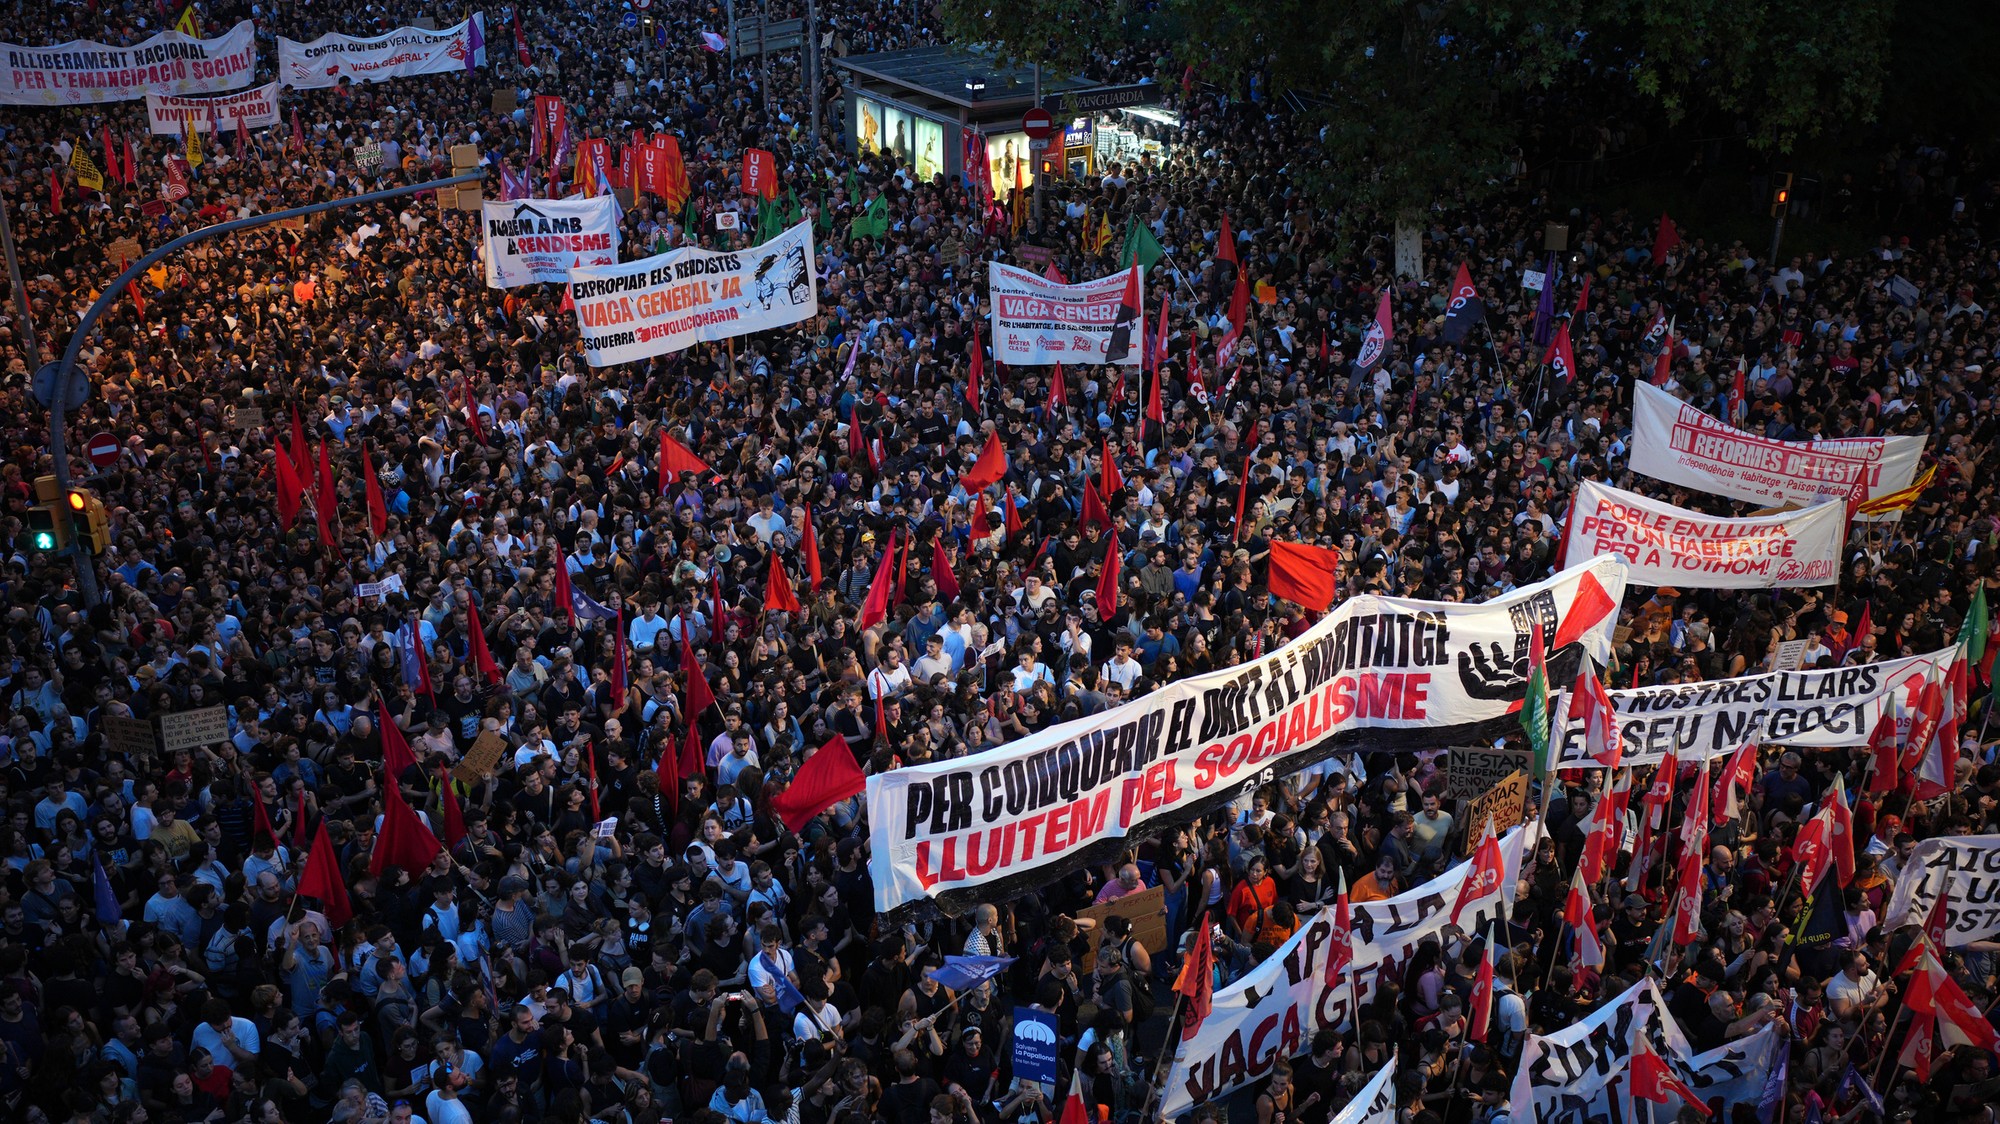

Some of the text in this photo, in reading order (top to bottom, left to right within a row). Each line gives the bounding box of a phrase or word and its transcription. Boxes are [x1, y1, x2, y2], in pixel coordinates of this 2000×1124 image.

[10, 42, 209, 70] ALLIBERAMENT NACIONAL
[304, 44, 345, 58] CONTRA
[347, 43, 365, 53] QUI
[367, 41, 388, 51] ENS
[389, 37, 408, 47] VEN
[409, 35, 423, 44] AL
[350, 53, 423, 72] VAGA GENERAL
[12, 70, 48, 90] PER
[159, 90, 264, 107] VOLEM SEGUIR
[229, 101, 271, 117] BARRI
[1074, 90, 1144, 108] VANGUARDIA
[1066, 132, 1083, 142] ATM
[593, 143, 605, 167] UG
[623, 149, 631, 183] UGT
[645, 149, 655, 184] UGT
[750, 153, 760, 187] UGT
[538, 217, 583, 235] AMB
[518, 233, 611, 254] RENDISME
[573, 273, 647, 299] EXPROPIAR
[650, 266, 672, 286] ELS
[580, 276, 743, 328] VAGA GENERAL JA
[1005, 299, 1121, 321] VAGA GENERA
[1447, 286, 1475, 318] CGT
[999, 320, 1011, 328] PER
[1054, 323, 1066, 331] ELS
[1679, 405, 1699, 426] NI
[1672, 425, 1692, 449] NI
[1694, 433, 1782, 472] REFORMES
[1785, 455, 1807, 477] DE
[1678, 455, 1735, 478] Independència
[1740, 470, 1781, 488] Habitatge
[1596, 499, 1790, 540] POBLE EN LLUITA
[1581, 516, 1797, 557] PER UN HABITATGE
[1593, 538, 1770, 576] PER A TOTHOM!
[1803, 559, 1833, 579] ARRAN
[1627, 676, 1777, 713] NOSTRES
[1778, 664, 1881, 701] LLARS
[1620, 715, 1703, 758] SEU
[1712, 703, 1866, 750] NEGOCI
[905, 770, 974, 839] PER
[981, 709, 1165, 823] CONQUERIR
[1165, 696, 1196, 755] EL
[1199, 667, 1263, 745] DRET
[1265, 655, 1288, 716] A
[1451, 750, 1529, 771] NESTAR
[915, 787, 1111, 891] LLUITEM
[1119, 757, 1182, 829] PEL
[1194, 673, 1431, 790] SOCIALISME
[1473, 782, 1520, 817] NESTAR
[1388, 893, 1446, 933] LA
[630, 933, 648, 942] HARD
[1015, 1043, 1037, 1052] Salvem
[1023, 1050, 1056, 1063] Papallona!
[1185, 1002, 1300, 1106] VAGA
